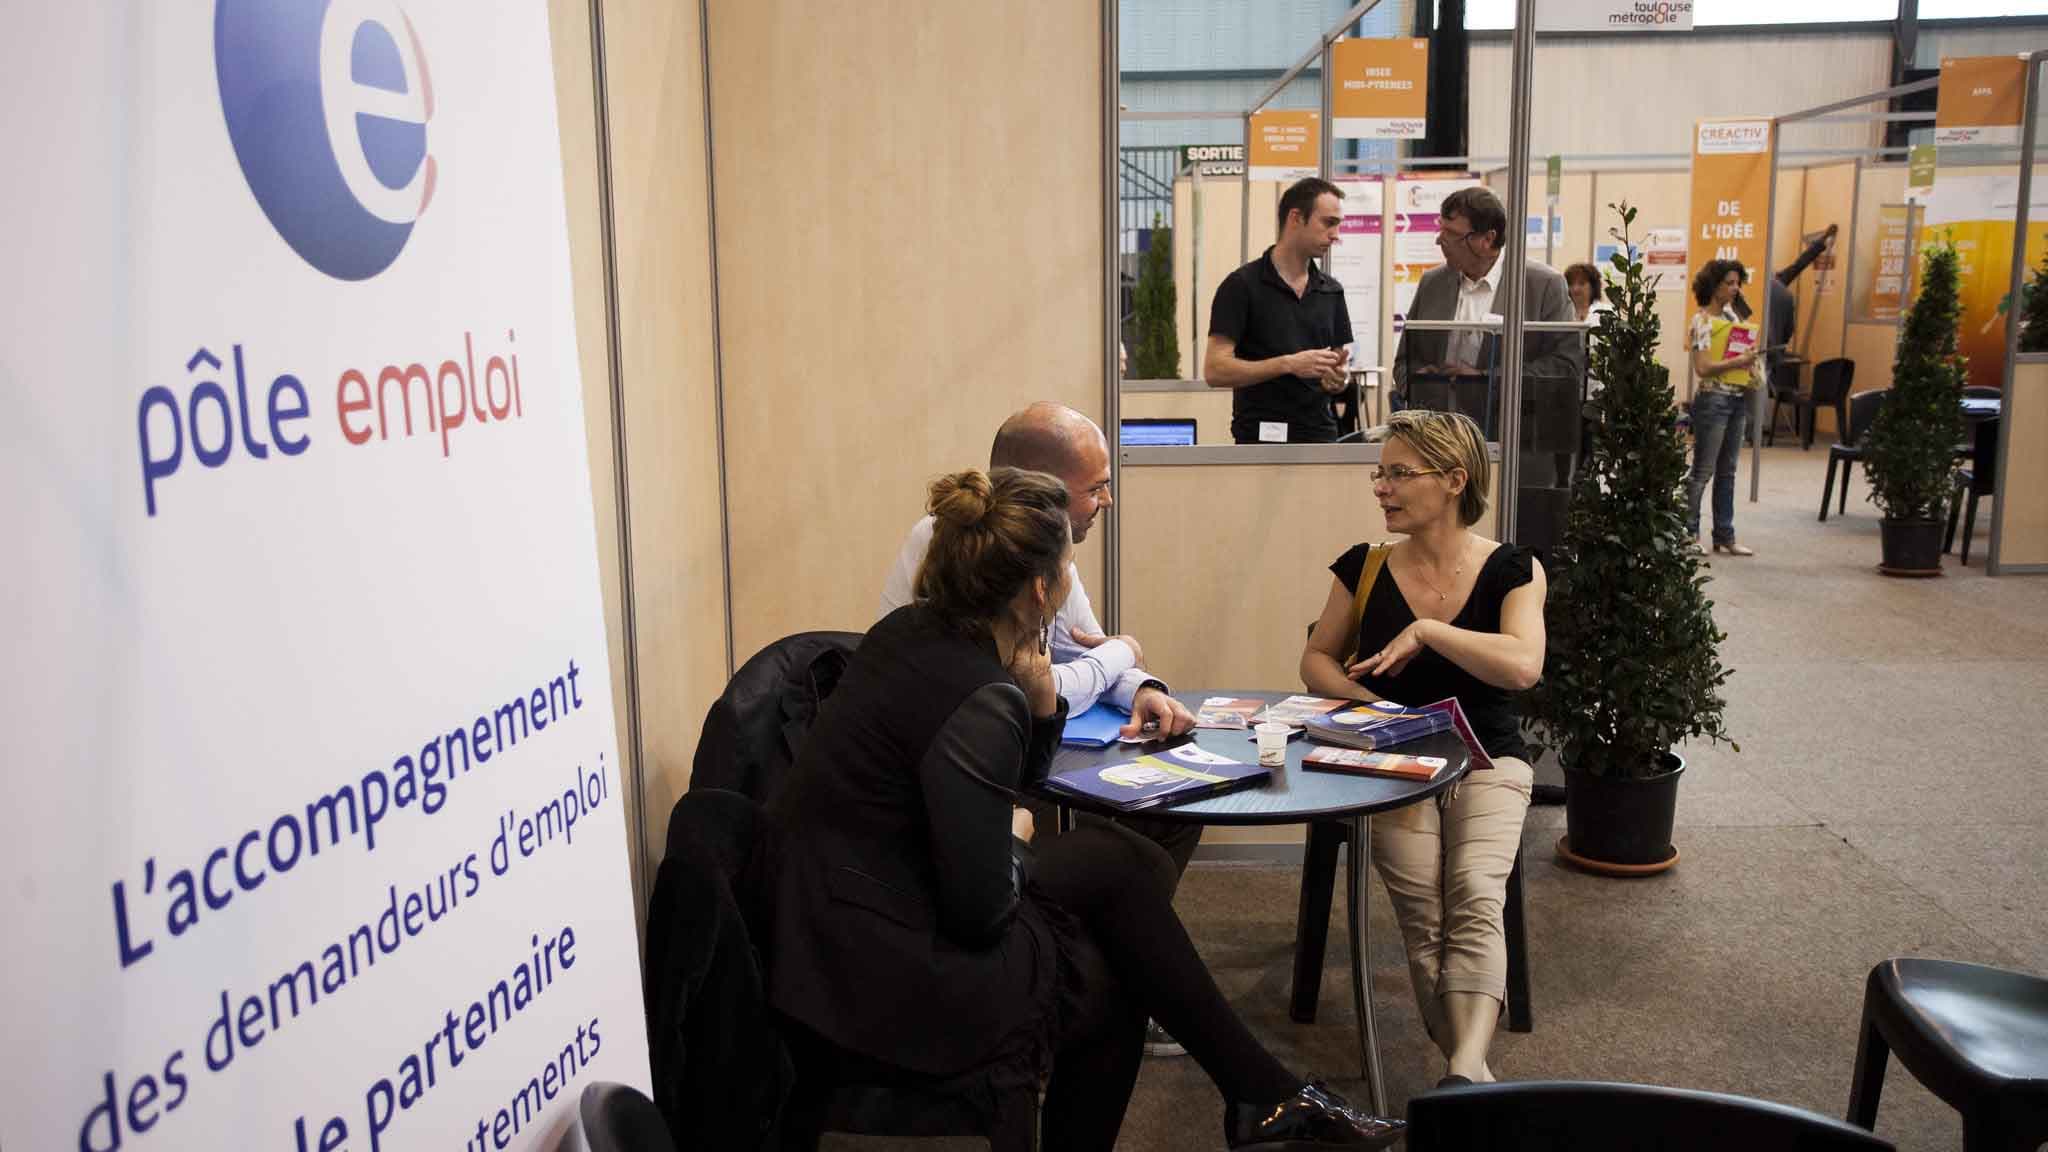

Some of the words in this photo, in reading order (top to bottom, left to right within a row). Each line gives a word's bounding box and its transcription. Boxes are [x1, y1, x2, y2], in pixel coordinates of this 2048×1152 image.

[1634, 1, 1692, 13] toulouse
[1187, 146, 1243, 161] SORTIE
[1702, 219, 1754, 240] L'IDÉE
[1717, 200, 1741, 217] DE
[1715, 246, 1738, 261] AU
[138, 344, 311, 518] pôle
[336, 329, 523, 458] emploi
[111, 658, 583, 970] L'accompagnement
[78, 1049, 189, 1152] des
[204, 853, 480, 1072] demandeurs
[490, 753, 609, 877] d'emploi
[366, 926, 576, 1152] partenaire
[467, 1017, 601, 1152] tements
